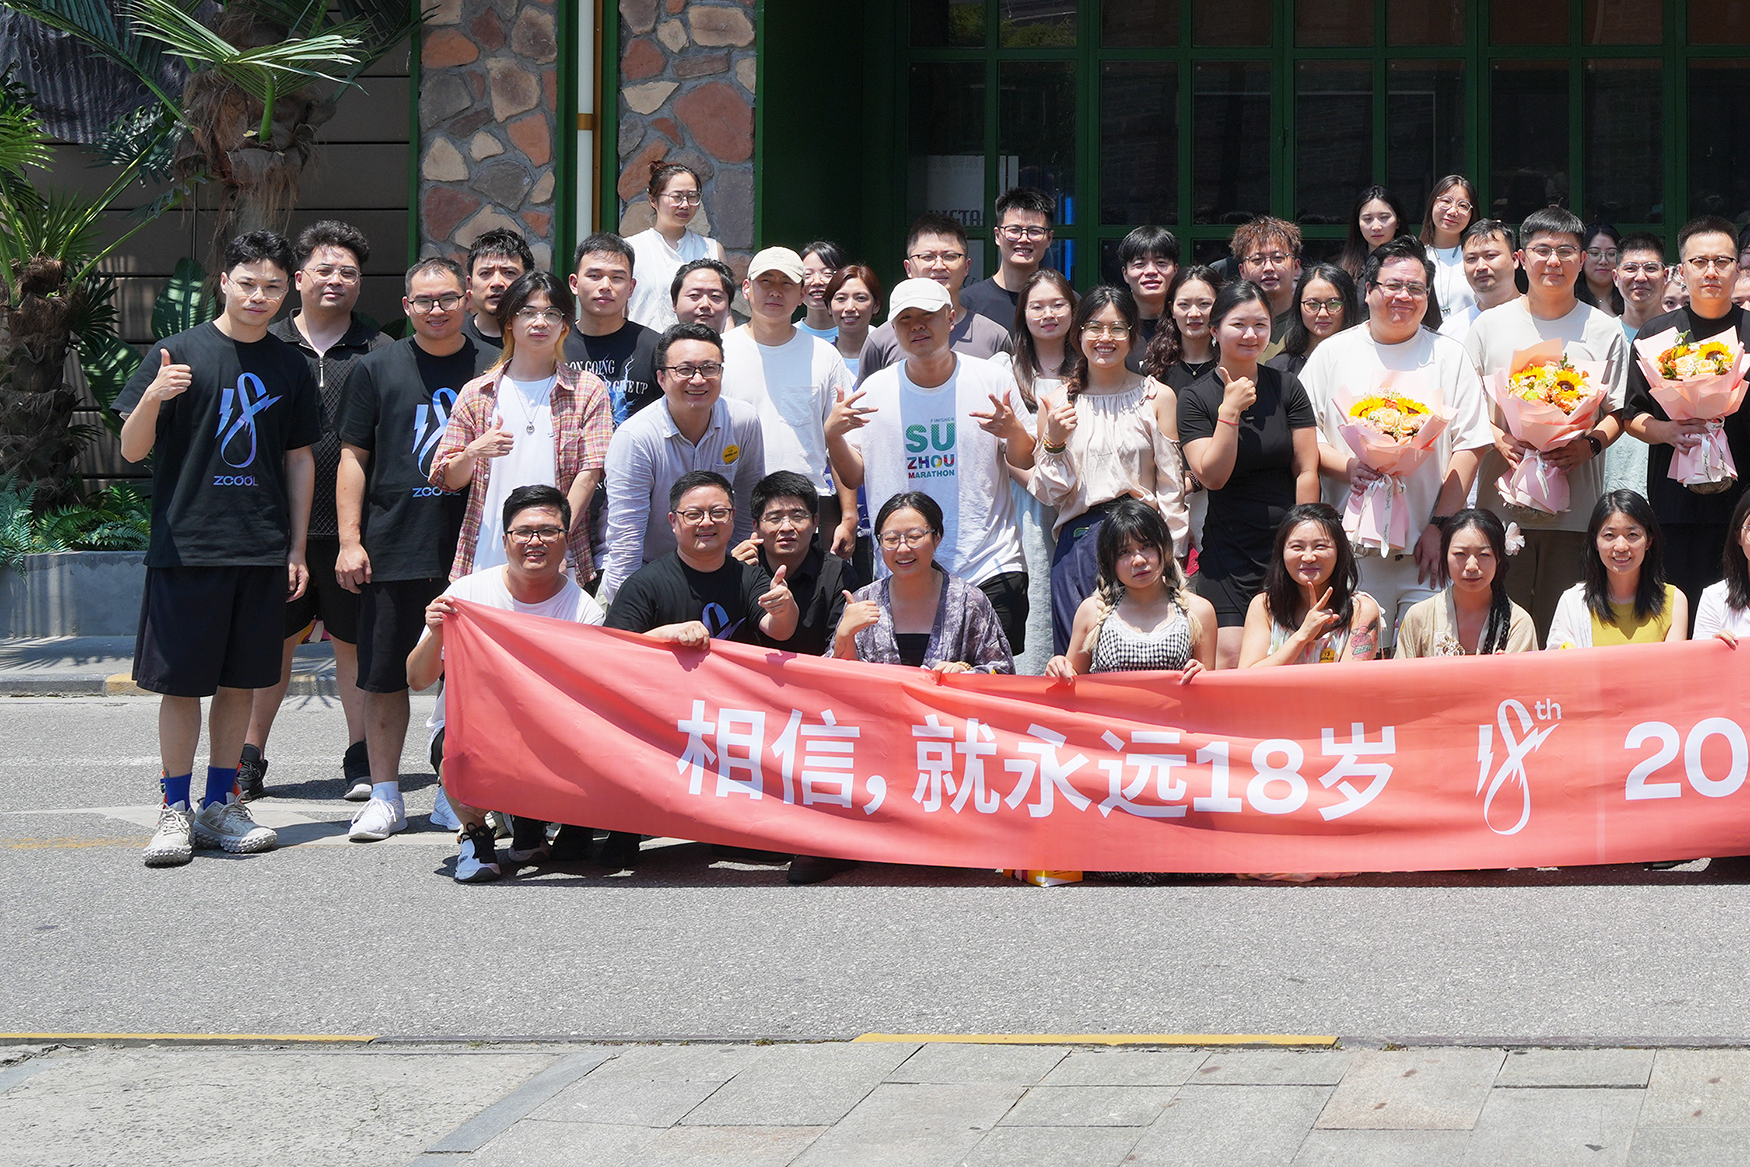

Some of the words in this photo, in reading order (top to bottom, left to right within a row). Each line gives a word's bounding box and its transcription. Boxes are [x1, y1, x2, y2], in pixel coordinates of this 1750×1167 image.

[635, 381, 649, 395] UP
[905, 422, 956, 453] SU
[906, 453, 955, 470] ZHOU
[213, 475, 259, 486] ZCOOL
[908, 469, 955, 479] MARATHON
[677, 699, 1397, 822] 相信，就永远18岁
